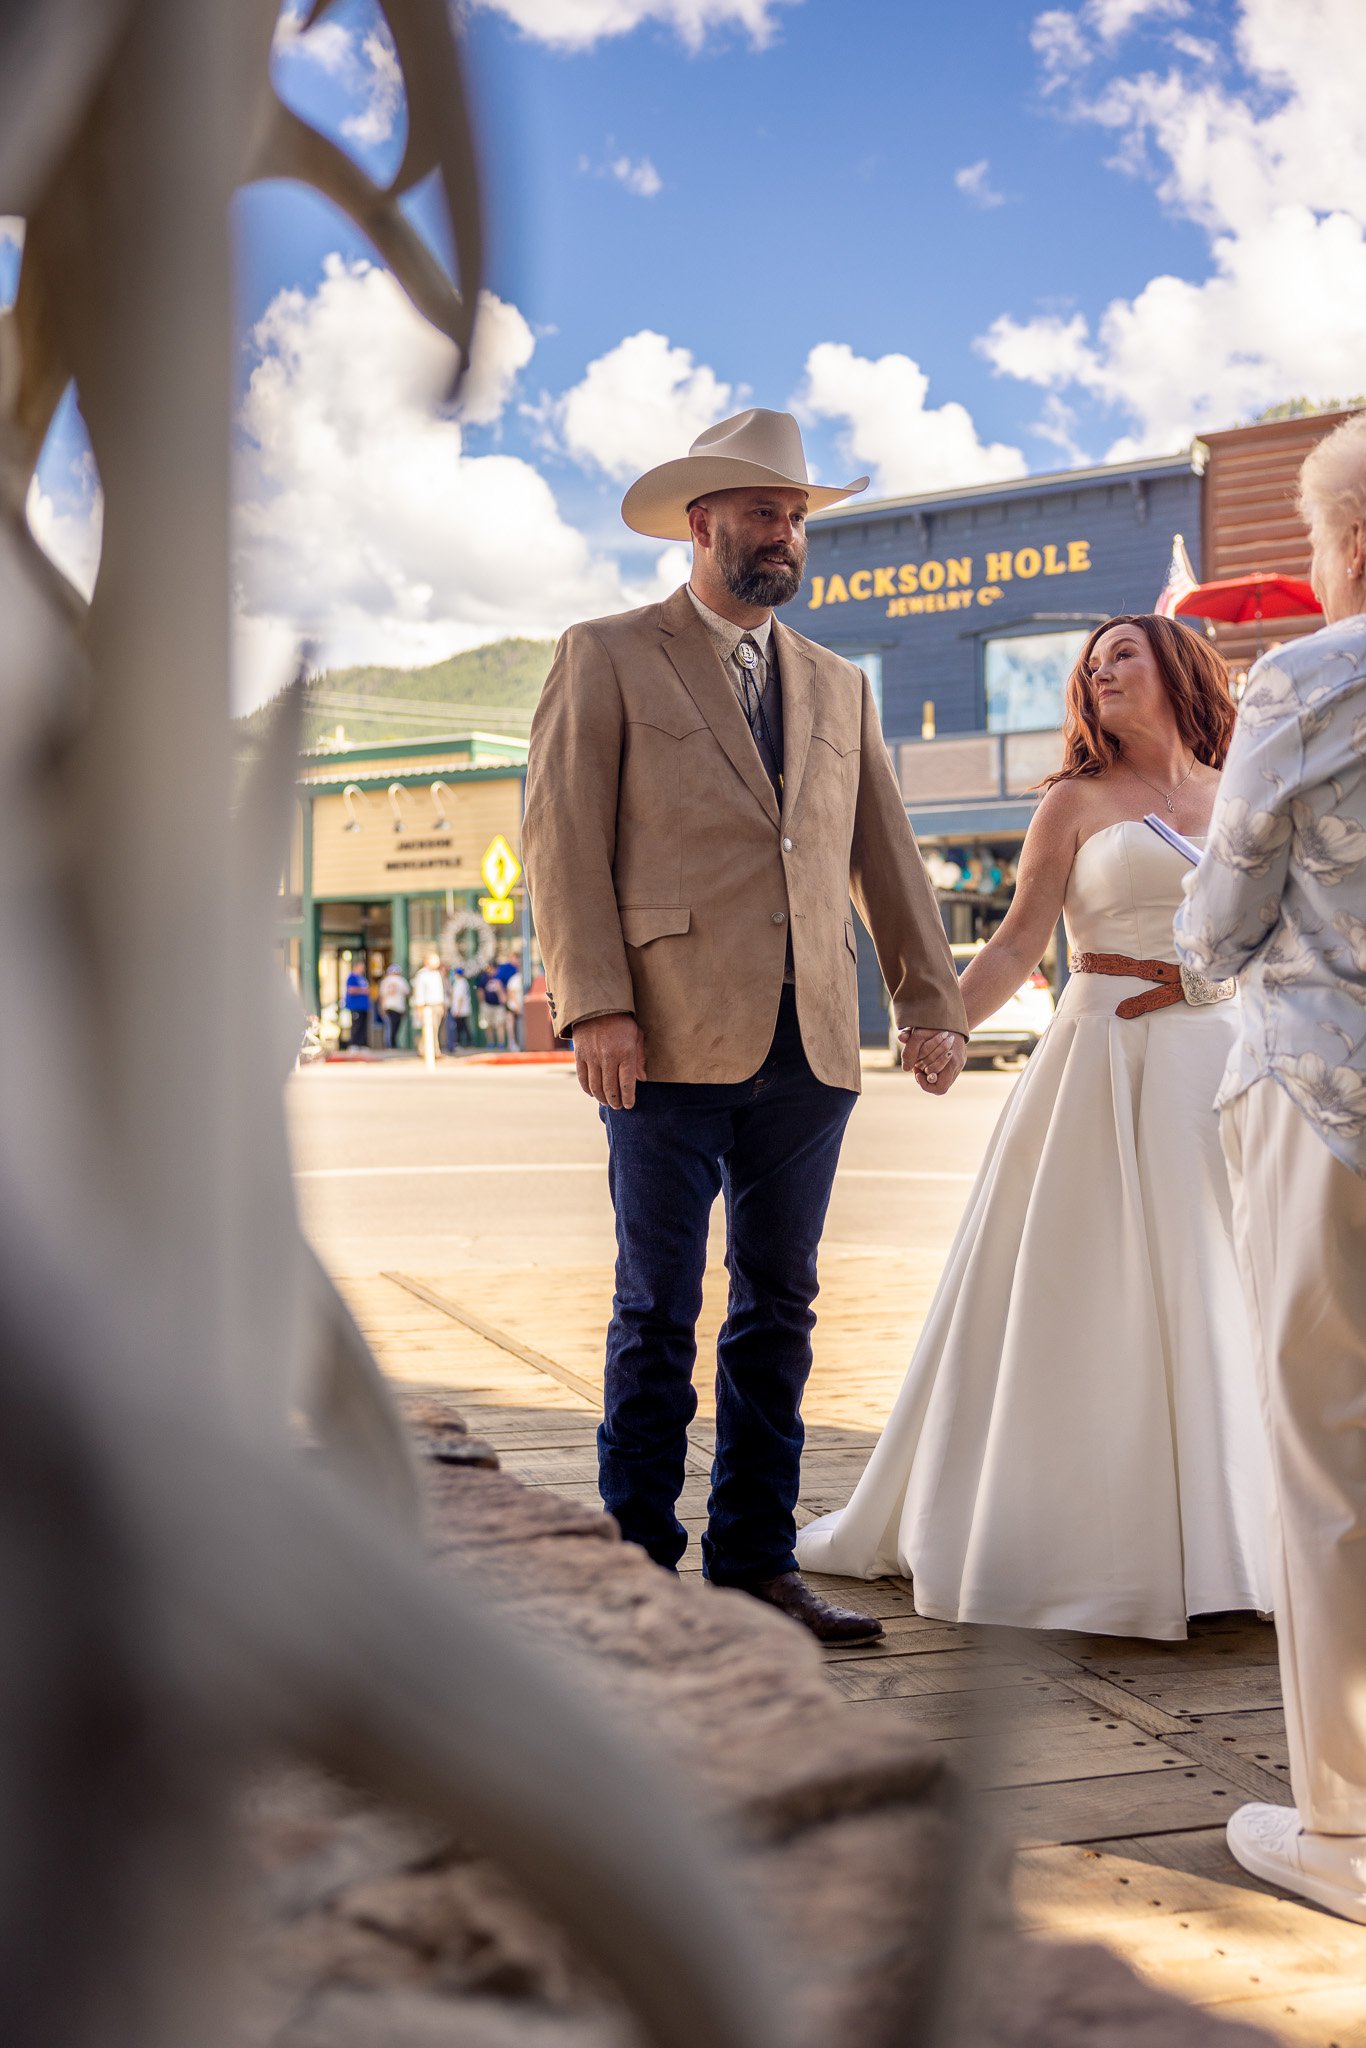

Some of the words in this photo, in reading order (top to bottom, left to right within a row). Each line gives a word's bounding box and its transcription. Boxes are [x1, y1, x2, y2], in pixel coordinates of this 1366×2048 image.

[809, 557, 972, 609] JACKSON
[986, 541, 1091, 582] HOLE
[886, 590, 973, 617] JEWELRY
